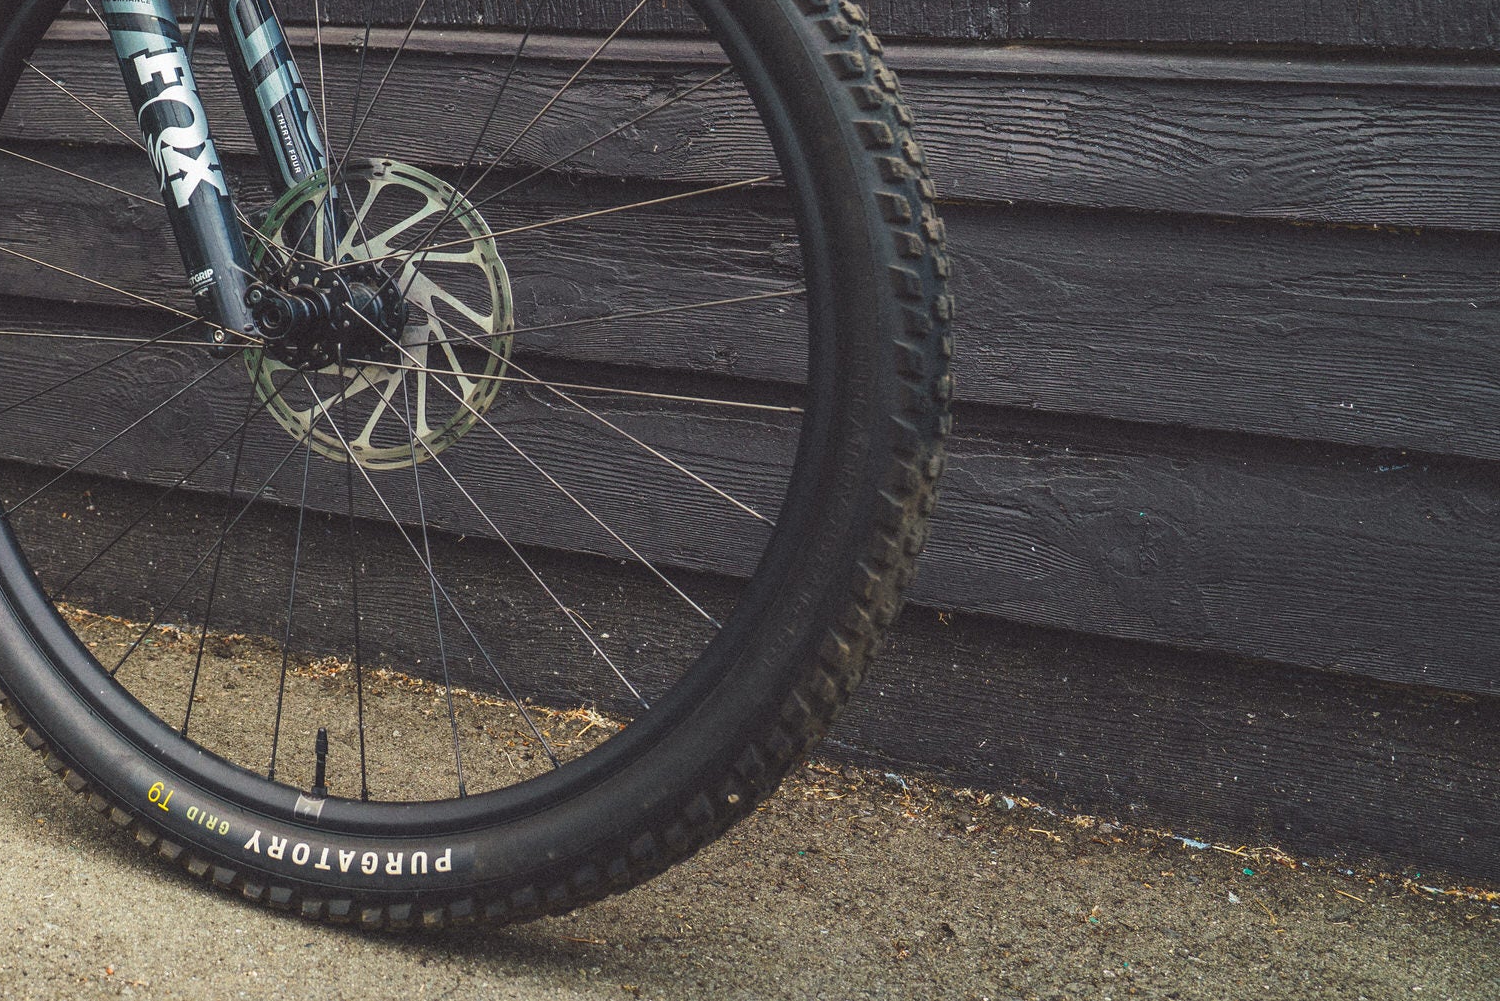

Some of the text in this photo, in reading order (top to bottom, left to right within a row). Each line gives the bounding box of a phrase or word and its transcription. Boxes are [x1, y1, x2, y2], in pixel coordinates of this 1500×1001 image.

[138, 46, 229, 209] FOX
[276, 112, 302, 174] THIRTY FOUR
[147, 781, 452, 876] PURGATORY GRID T9
